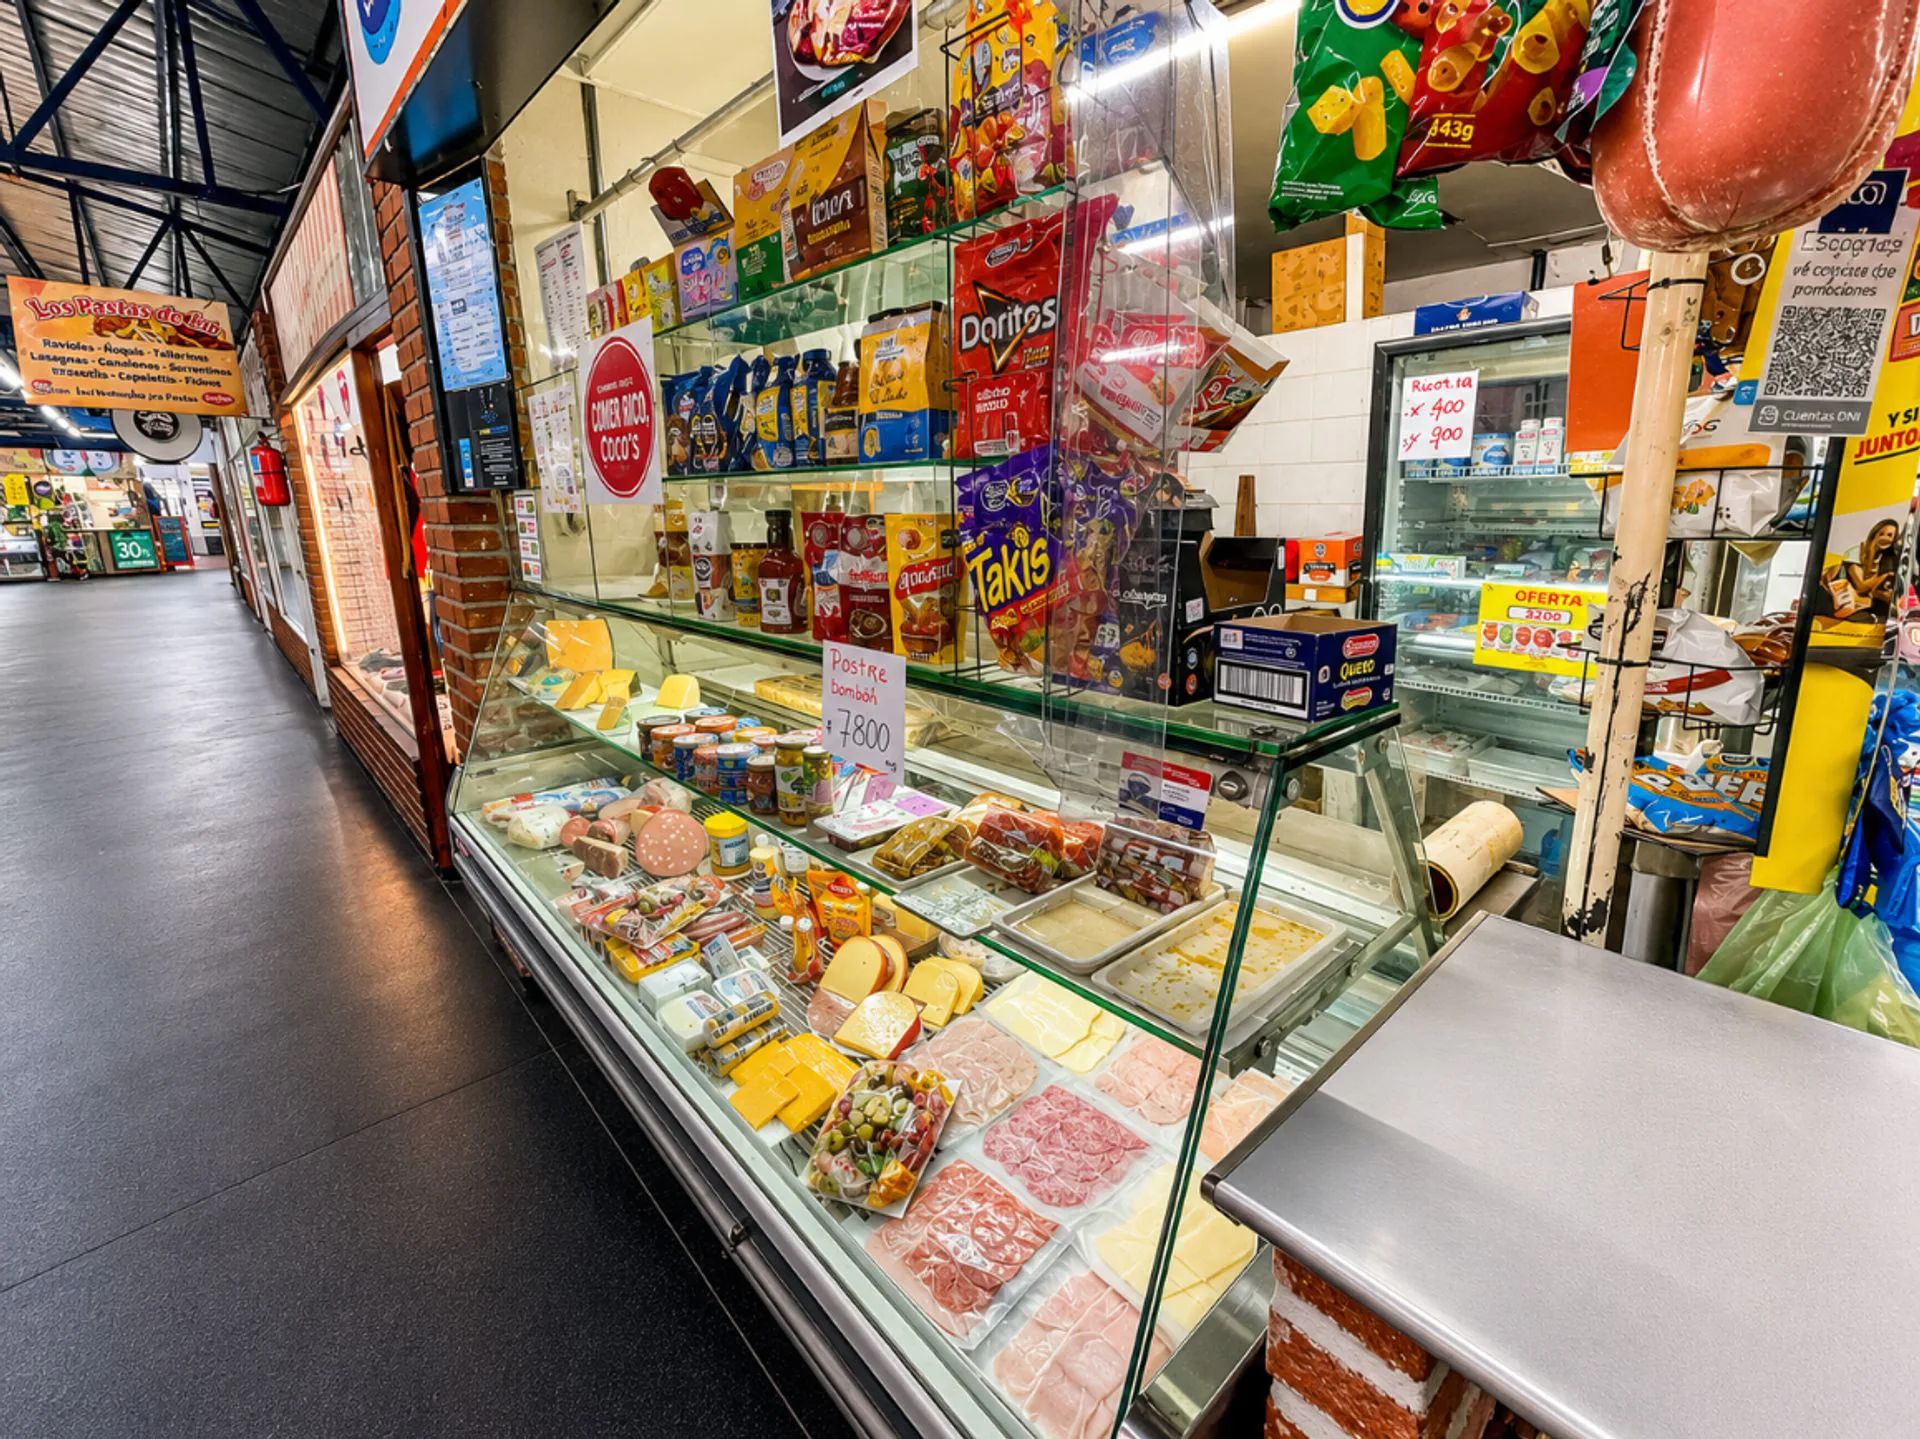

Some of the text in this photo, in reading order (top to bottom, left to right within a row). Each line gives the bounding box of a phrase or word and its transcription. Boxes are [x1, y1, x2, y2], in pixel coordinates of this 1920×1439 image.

[960, 298, 1057, 350] Doritos
[1854, 427, 1920, 459] JUNTO
[968, 537, 1050, 612] Takis
[1515, 589, 1582, 606] OFERTA
[837, 708, 890, 752] 7800
